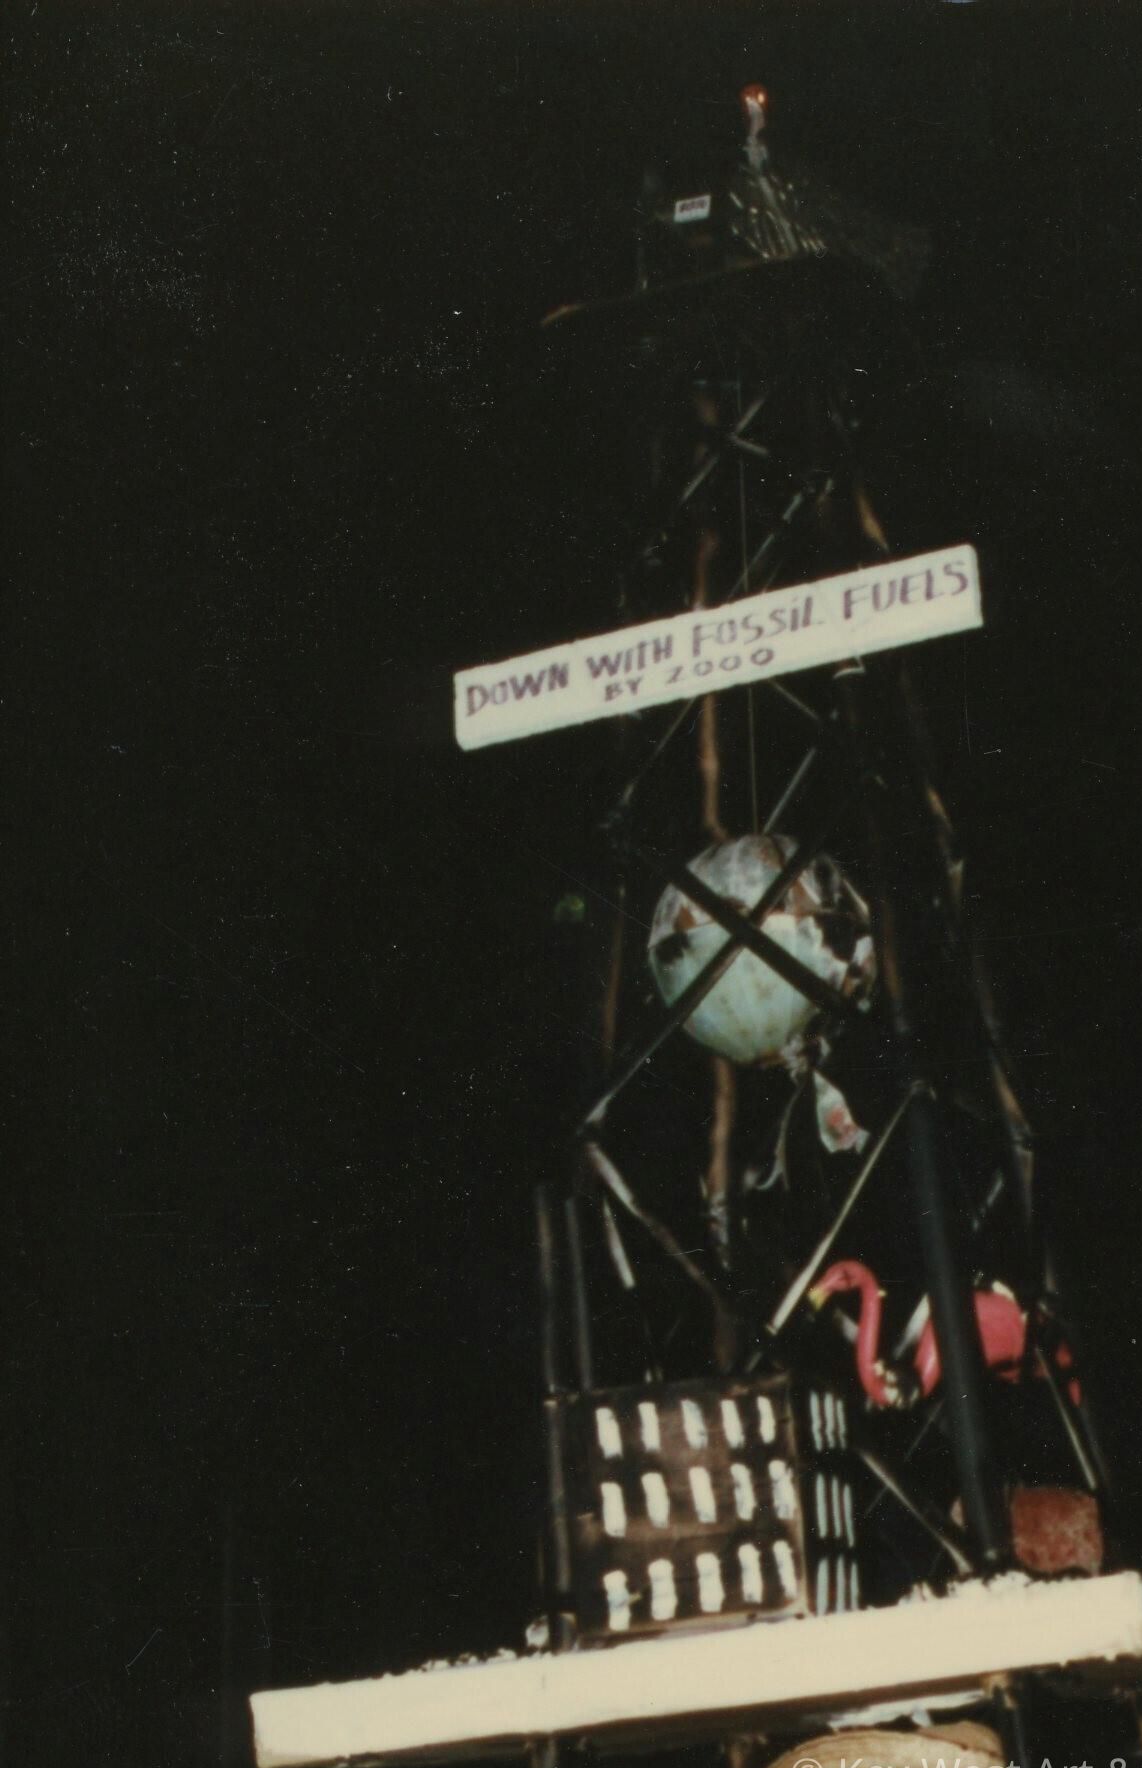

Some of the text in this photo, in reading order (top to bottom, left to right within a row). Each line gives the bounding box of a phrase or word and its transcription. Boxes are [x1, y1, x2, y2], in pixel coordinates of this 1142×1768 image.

[465, 663, 571, 717] DOWN
[586, 632, 674, 678] WITH
[842, 560, 969, 621] FUELS
[603, 647, 776, 702] BY 2000
